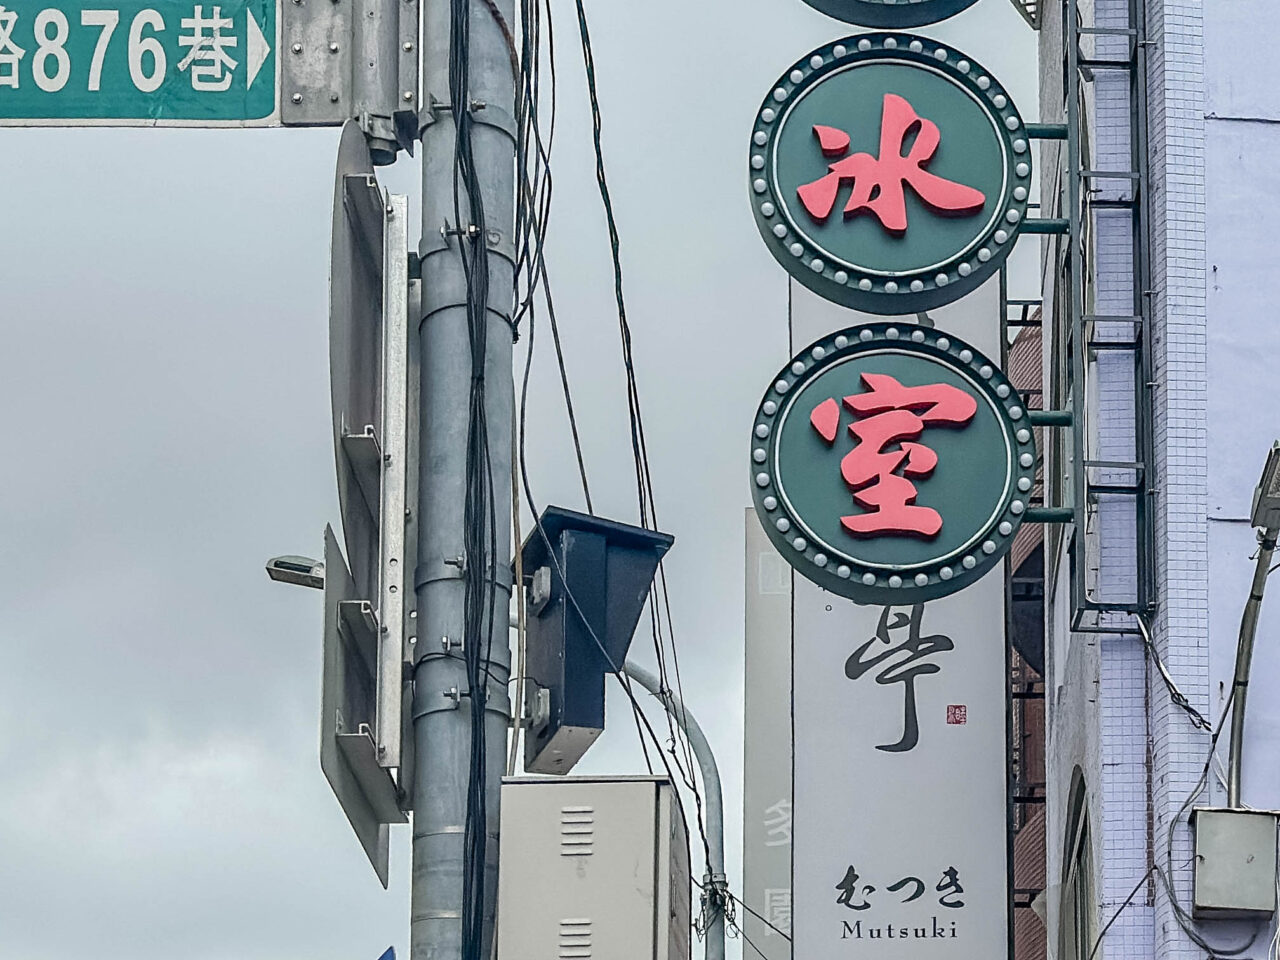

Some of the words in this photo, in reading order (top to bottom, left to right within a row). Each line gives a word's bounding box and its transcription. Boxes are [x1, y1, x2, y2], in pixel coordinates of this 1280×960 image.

[835, 864, 965, 911] むつき
[840, 916, 958, 939] Mutsuki
